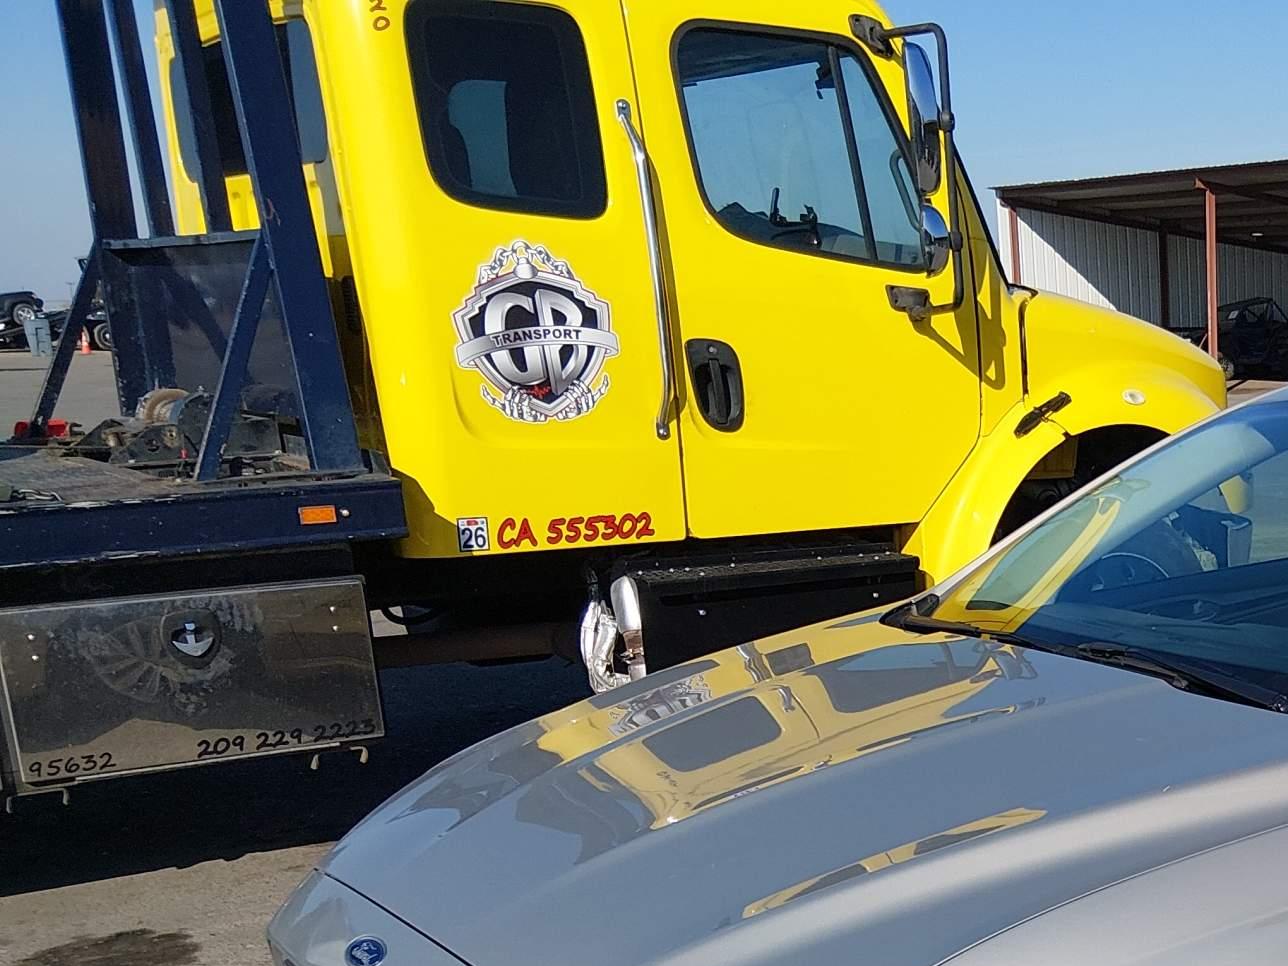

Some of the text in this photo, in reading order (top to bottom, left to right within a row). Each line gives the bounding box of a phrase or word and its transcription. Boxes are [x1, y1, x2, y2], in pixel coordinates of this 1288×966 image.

[492, 328, 582, 346] TRANSPORT
[461, 527, 486, 549] 26
[497, 512, 655, 549] CA 555302
[197, 735, 245, 758] 209
[255, 729, 303, 751] 229
[28, 752, 117, 778] 95632
